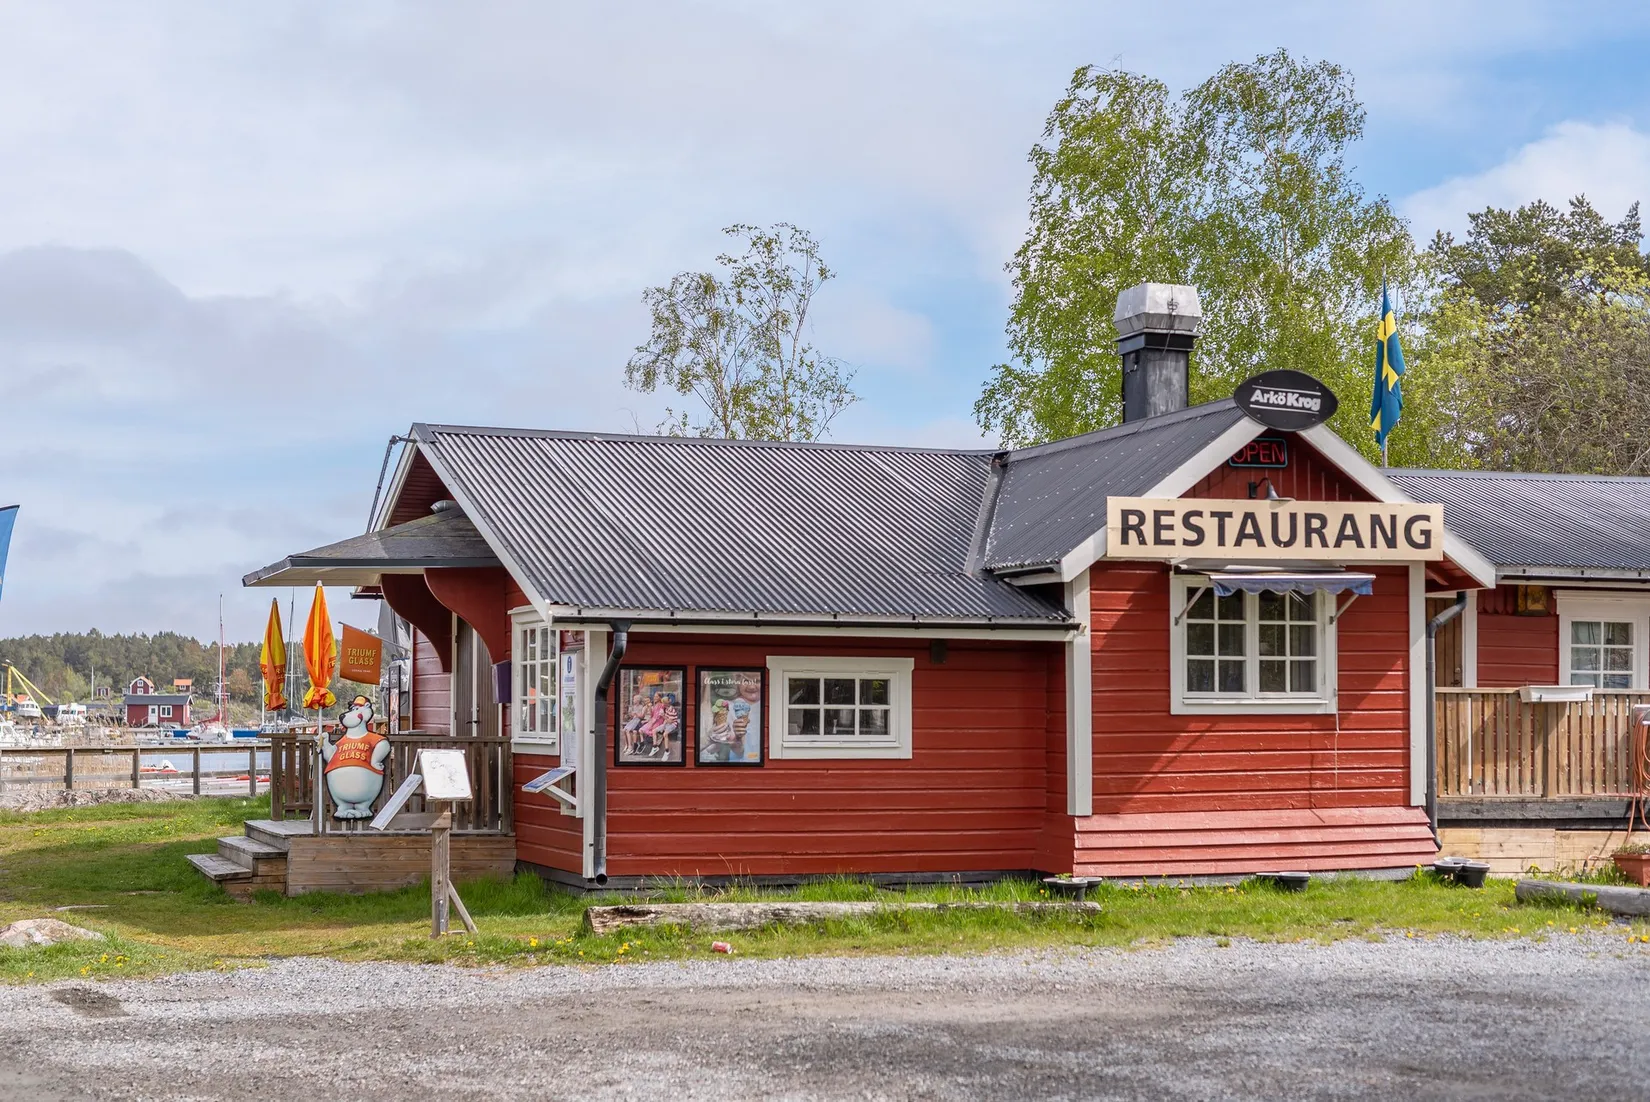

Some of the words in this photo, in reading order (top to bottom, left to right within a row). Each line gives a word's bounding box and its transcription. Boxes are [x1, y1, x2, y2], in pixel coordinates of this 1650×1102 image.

[1250, 389, 1286, 406] Arkö
[1286, 392, 1321, 411] Krog
[1120, 508, 1433, 550] RESTAURANG
[347, 648, 377, 657] TRIUMF
[348, 656, 374, 666] GLASS
[338, 742, 370, 753] TRIUMF
[340, 751, 367, 761] GLASS
